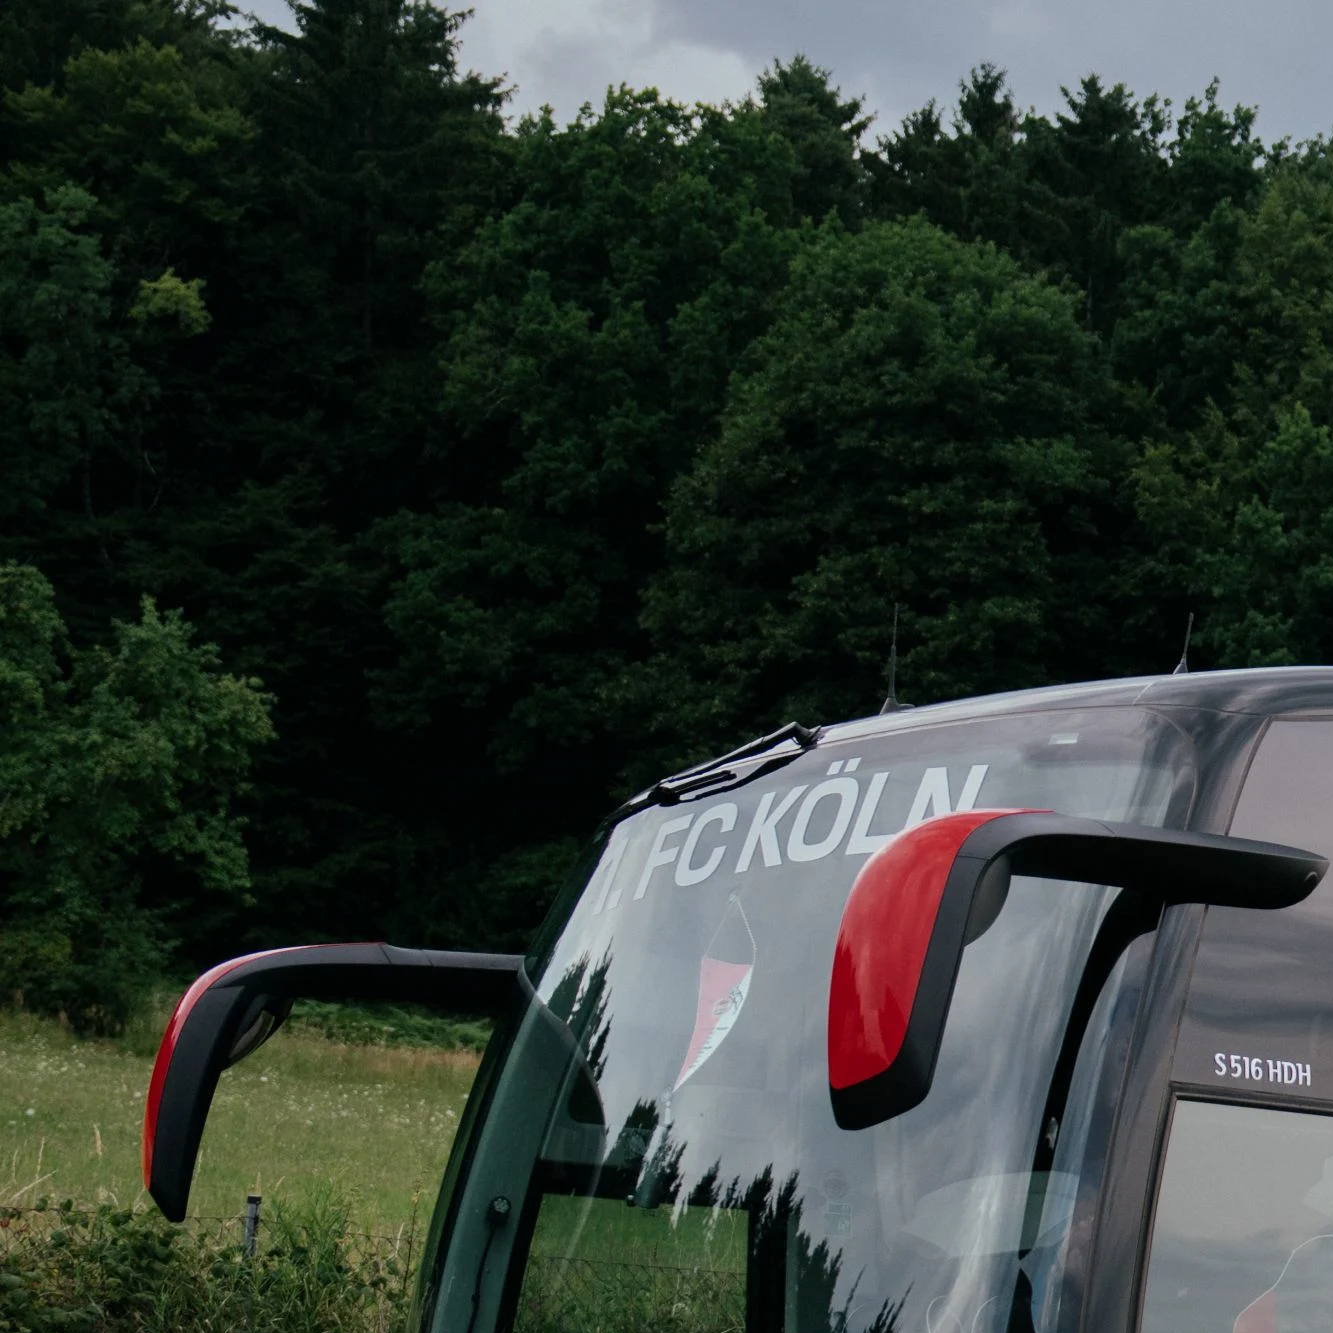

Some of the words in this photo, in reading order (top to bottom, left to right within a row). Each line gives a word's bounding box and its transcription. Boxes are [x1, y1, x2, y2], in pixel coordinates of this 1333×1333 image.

[592, 838, 629, 916] 1.
[633, 802, 738, 901] FC
[735, 757, 990, 874] KÖLN
[1214, 1053, 1227, 1076] S
[1230, 1055, 1263, 1080] 516
[1266, 1060, 1311, 1086] HDH
